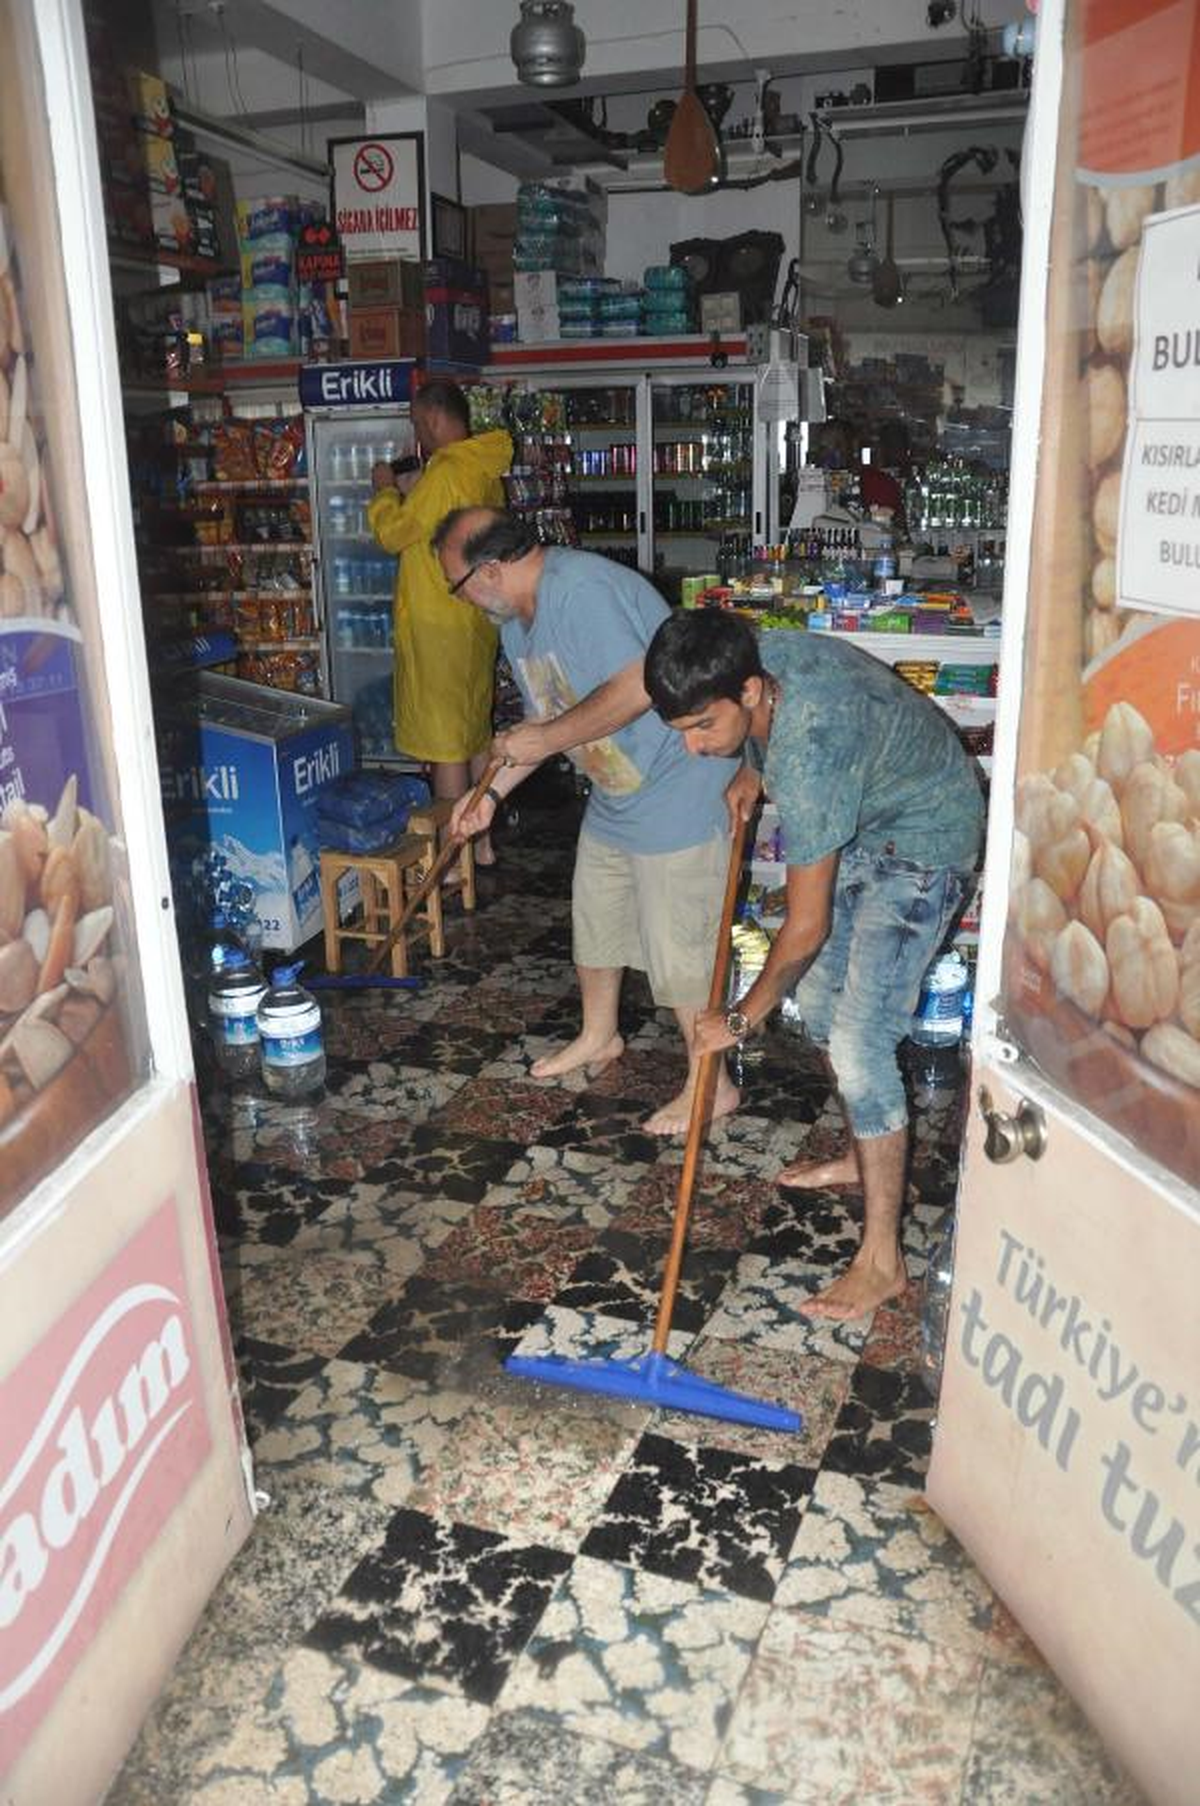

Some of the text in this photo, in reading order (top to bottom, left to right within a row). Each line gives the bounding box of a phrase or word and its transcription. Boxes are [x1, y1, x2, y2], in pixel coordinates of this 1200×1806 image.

[375, 203, 418, 236] İÇİLMEZ
[321, 367, 393, 400] Erikli
[1147, 487, 1188, 517] KEDİ
[161, 764, 239, 801] Erikli
[293, 741, 341, 795] Erikli
[960, 1288, 1082, 1472] tadı
